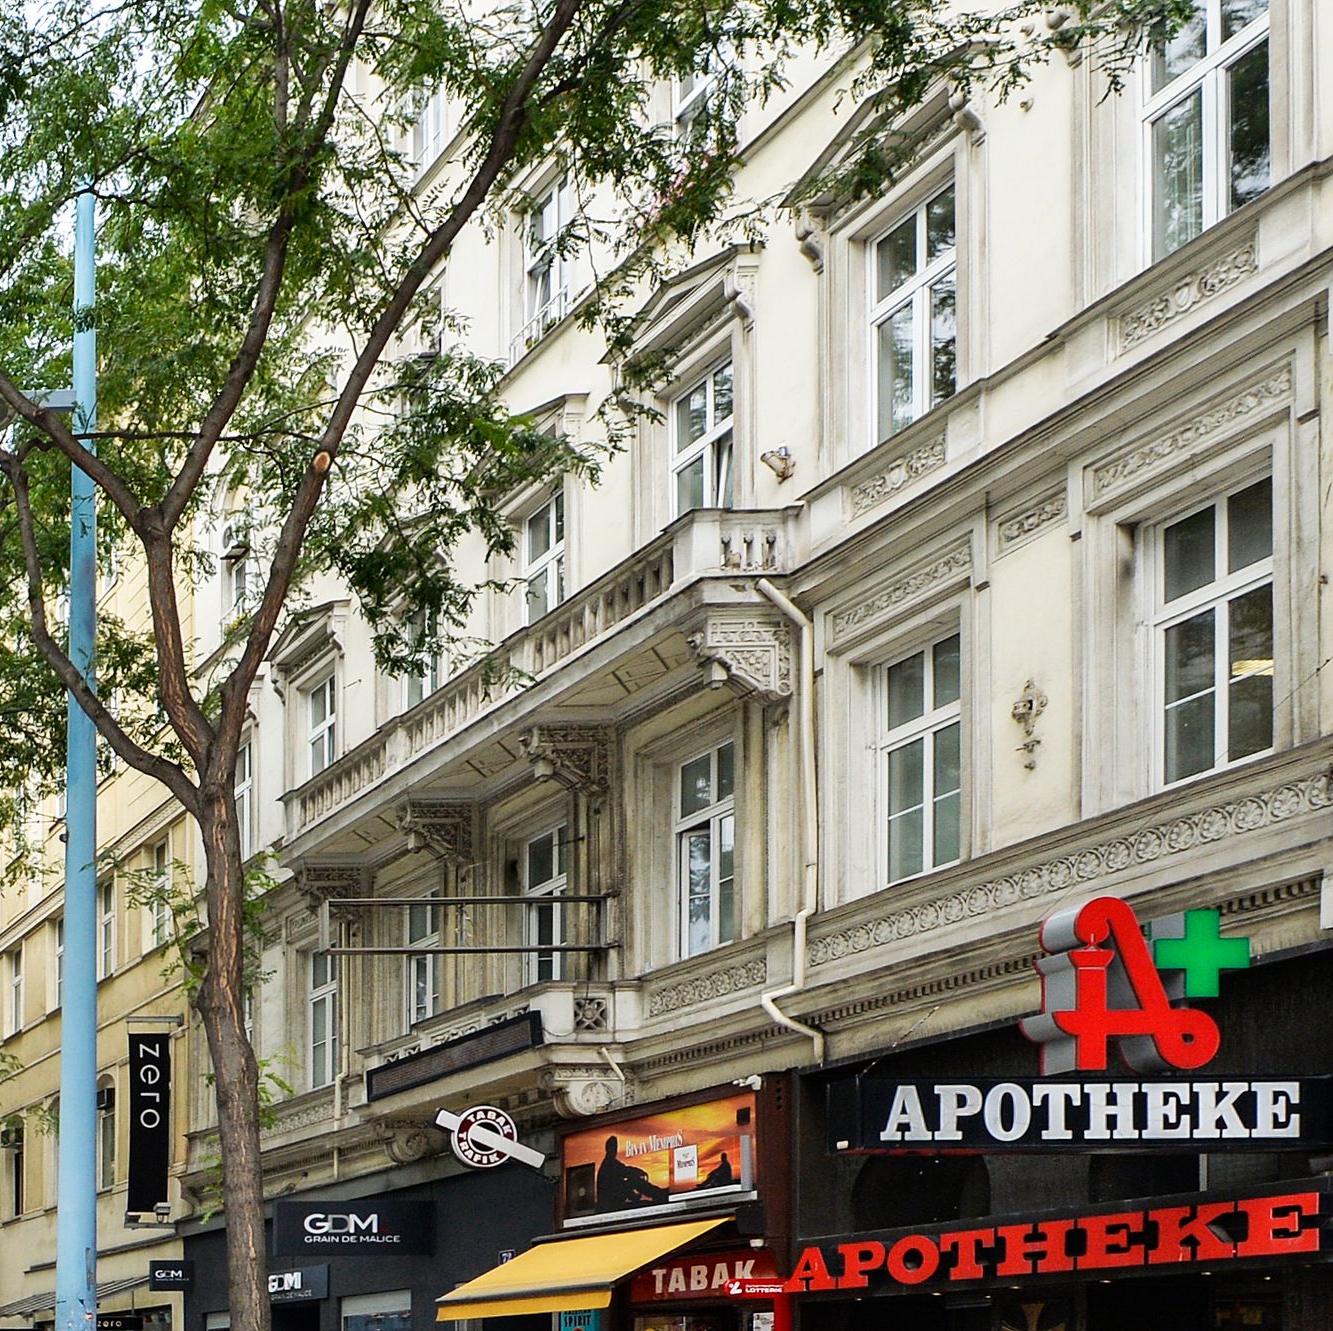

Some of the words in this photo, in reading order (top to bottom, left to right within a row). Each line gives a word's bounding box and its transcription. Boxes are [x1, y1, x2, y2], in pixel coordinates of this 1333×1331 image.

[139, 1043, 160, 1129] zero
[466, 1109, 513, 1135] TABAK
[879, 1081, 1301, 1142] APOTHEKE
[458, 1131, 500, 1164] TRAFIK
[648, 1129, 683, 1153] MEMPHIS
[303, 1213, 379, 1235] GDM
[304, 1235, 340, 1244] GRAIN
[342, 1235, 358, 1243] DE
[359, 1235, 401, 1243] MALICE
[783, 1191, 1320, 1293] APOTHEKE
[652, 1259, 755, 1294] TABAK
[564, 1315, 591, 1328] SPIRIT
